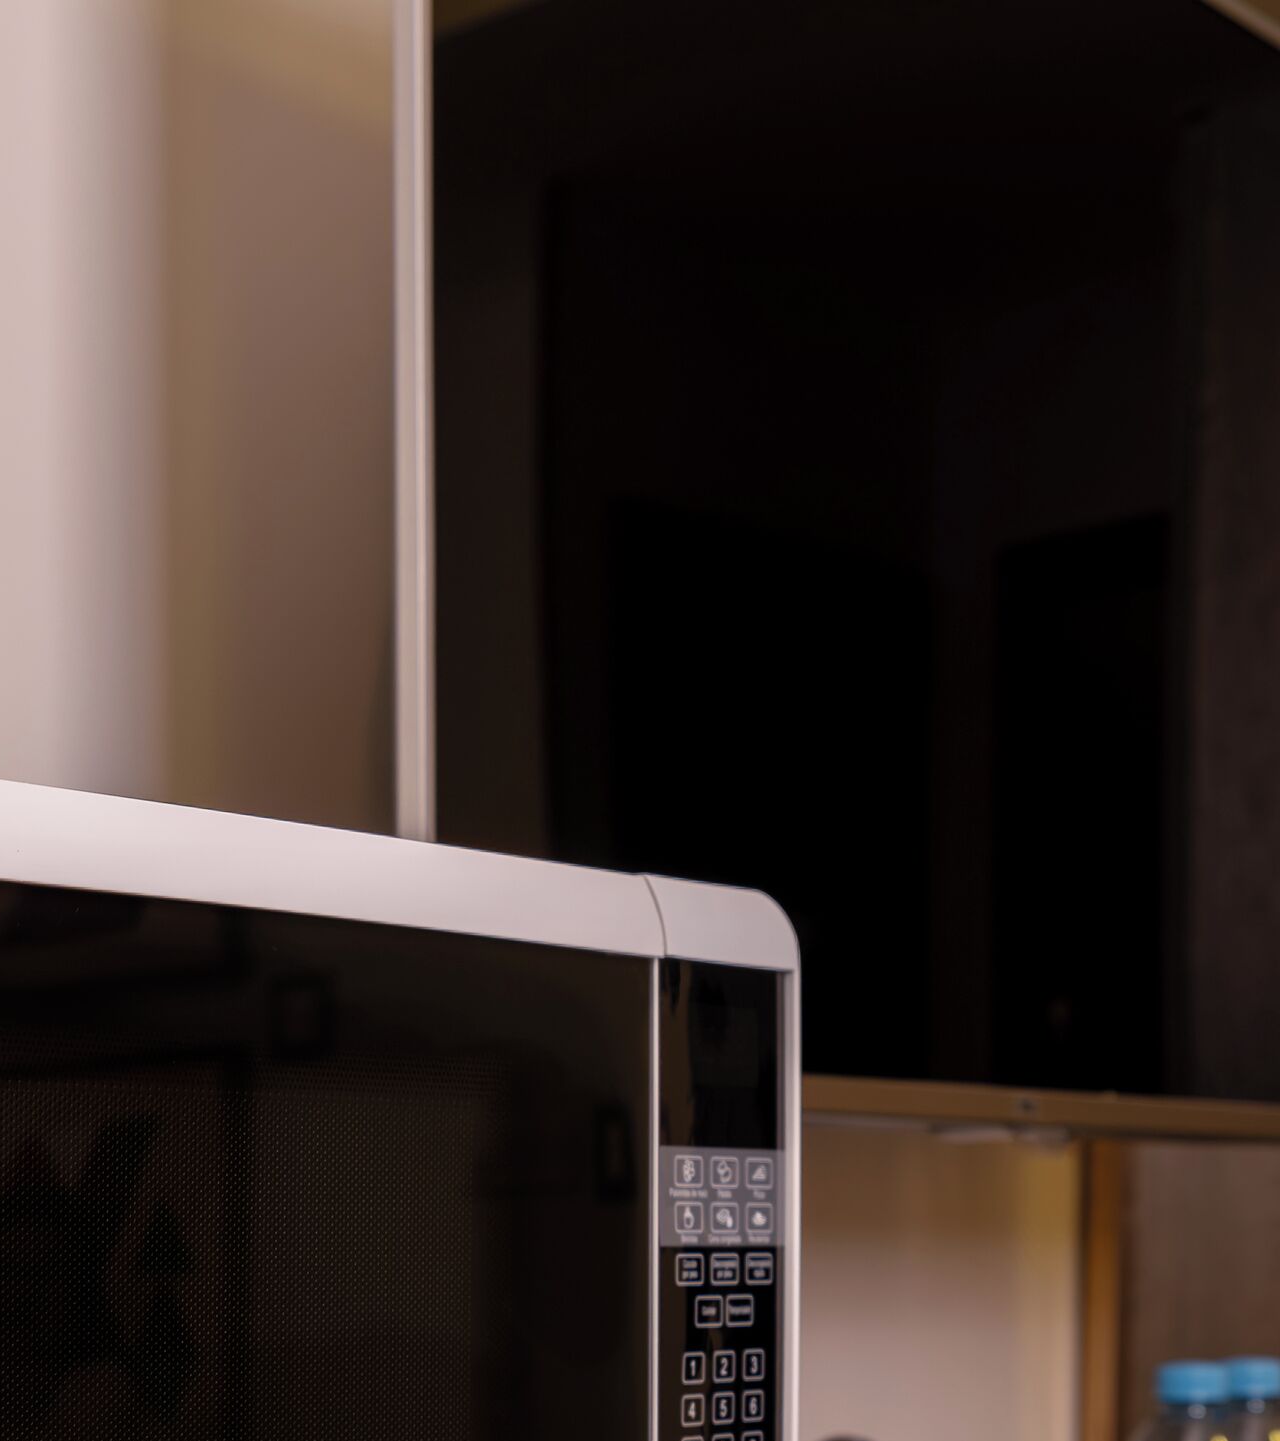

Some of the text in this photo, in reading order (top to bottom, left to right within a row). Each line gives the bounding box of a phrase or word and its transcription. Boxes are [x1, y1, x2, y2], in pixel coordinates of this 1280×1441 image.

[690, 1355, 758, 1376] 1 2 3
[688, 1396, 758, 1419] 4 5 6
